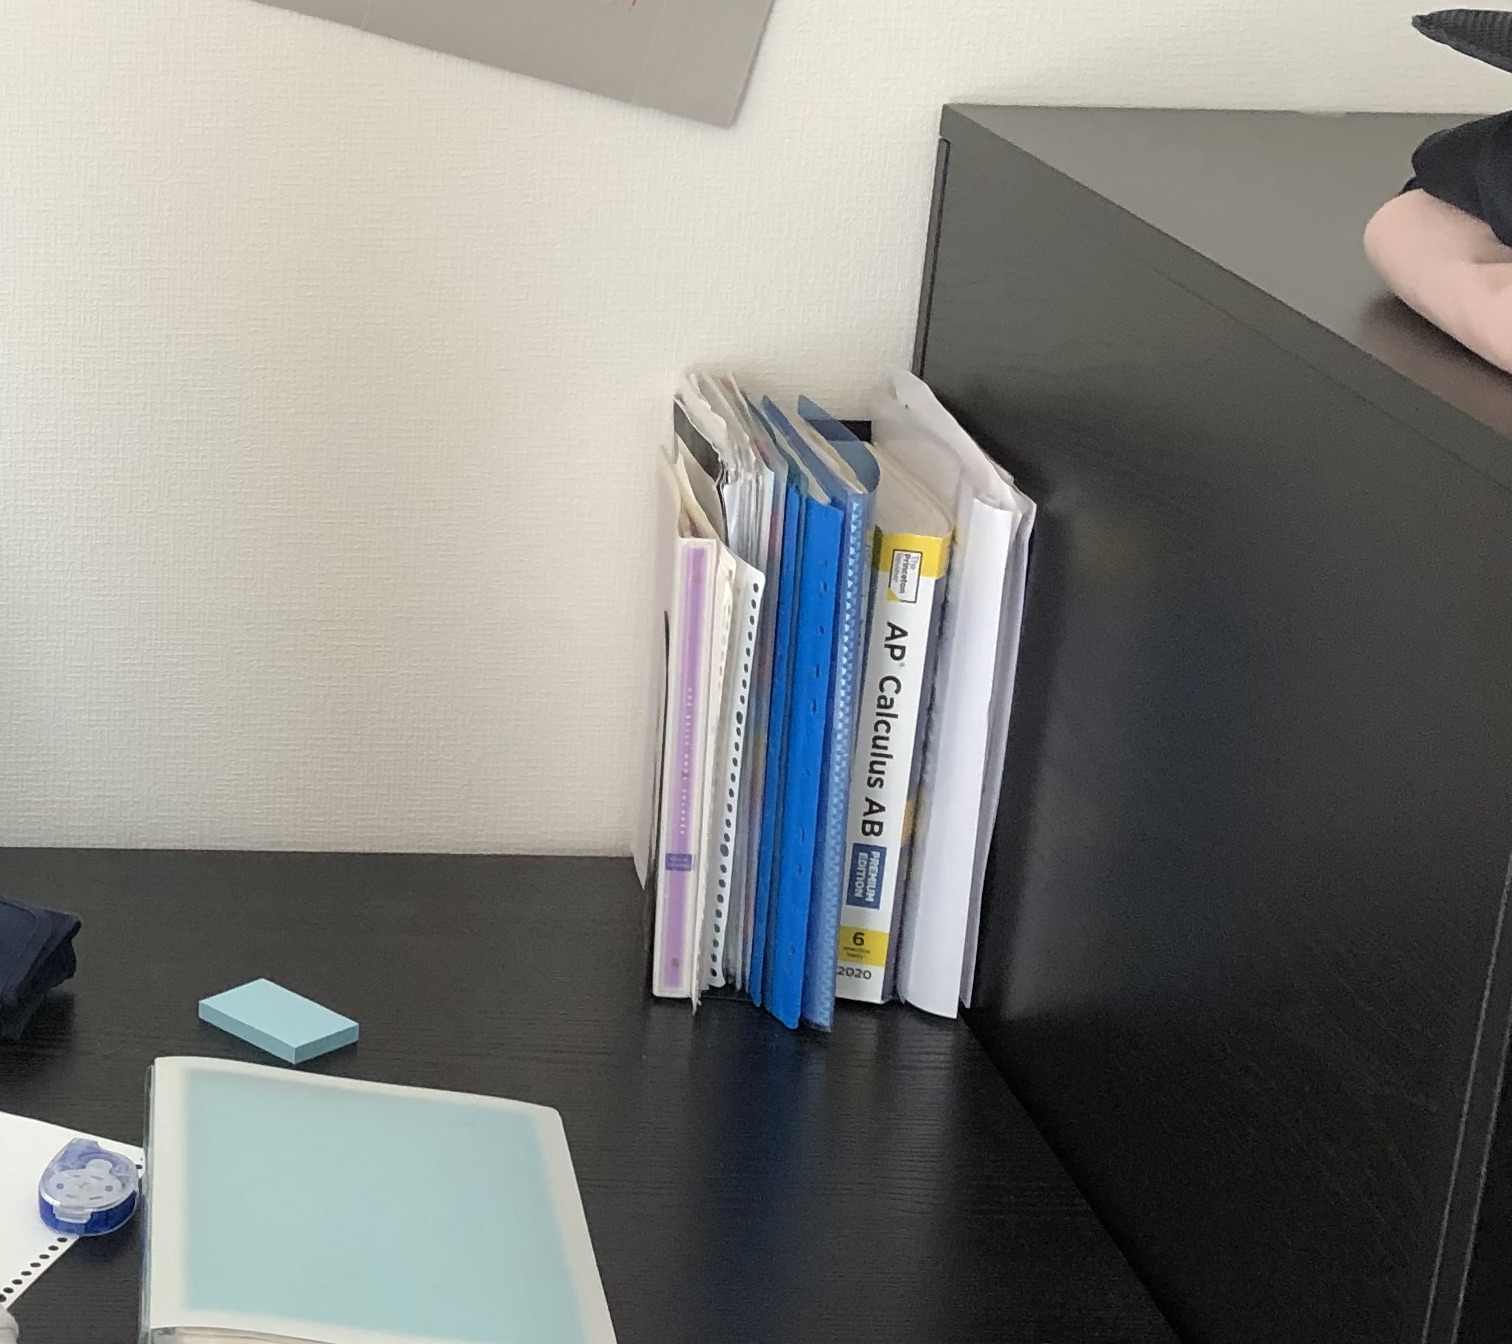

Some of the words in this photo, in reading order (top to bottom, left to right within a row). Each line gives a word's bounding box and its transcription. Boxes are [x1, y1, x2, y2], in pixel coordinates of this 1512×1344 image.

[867, 675, 902, 790] Calculus
[861, 797, 886, 838] AB
[854, 851, 869, 899] EDITION
[865, 850, 881, 903] PREMIUM
[852, 931, 866, 947] 6
[836, 966, 873, 981] 2020
